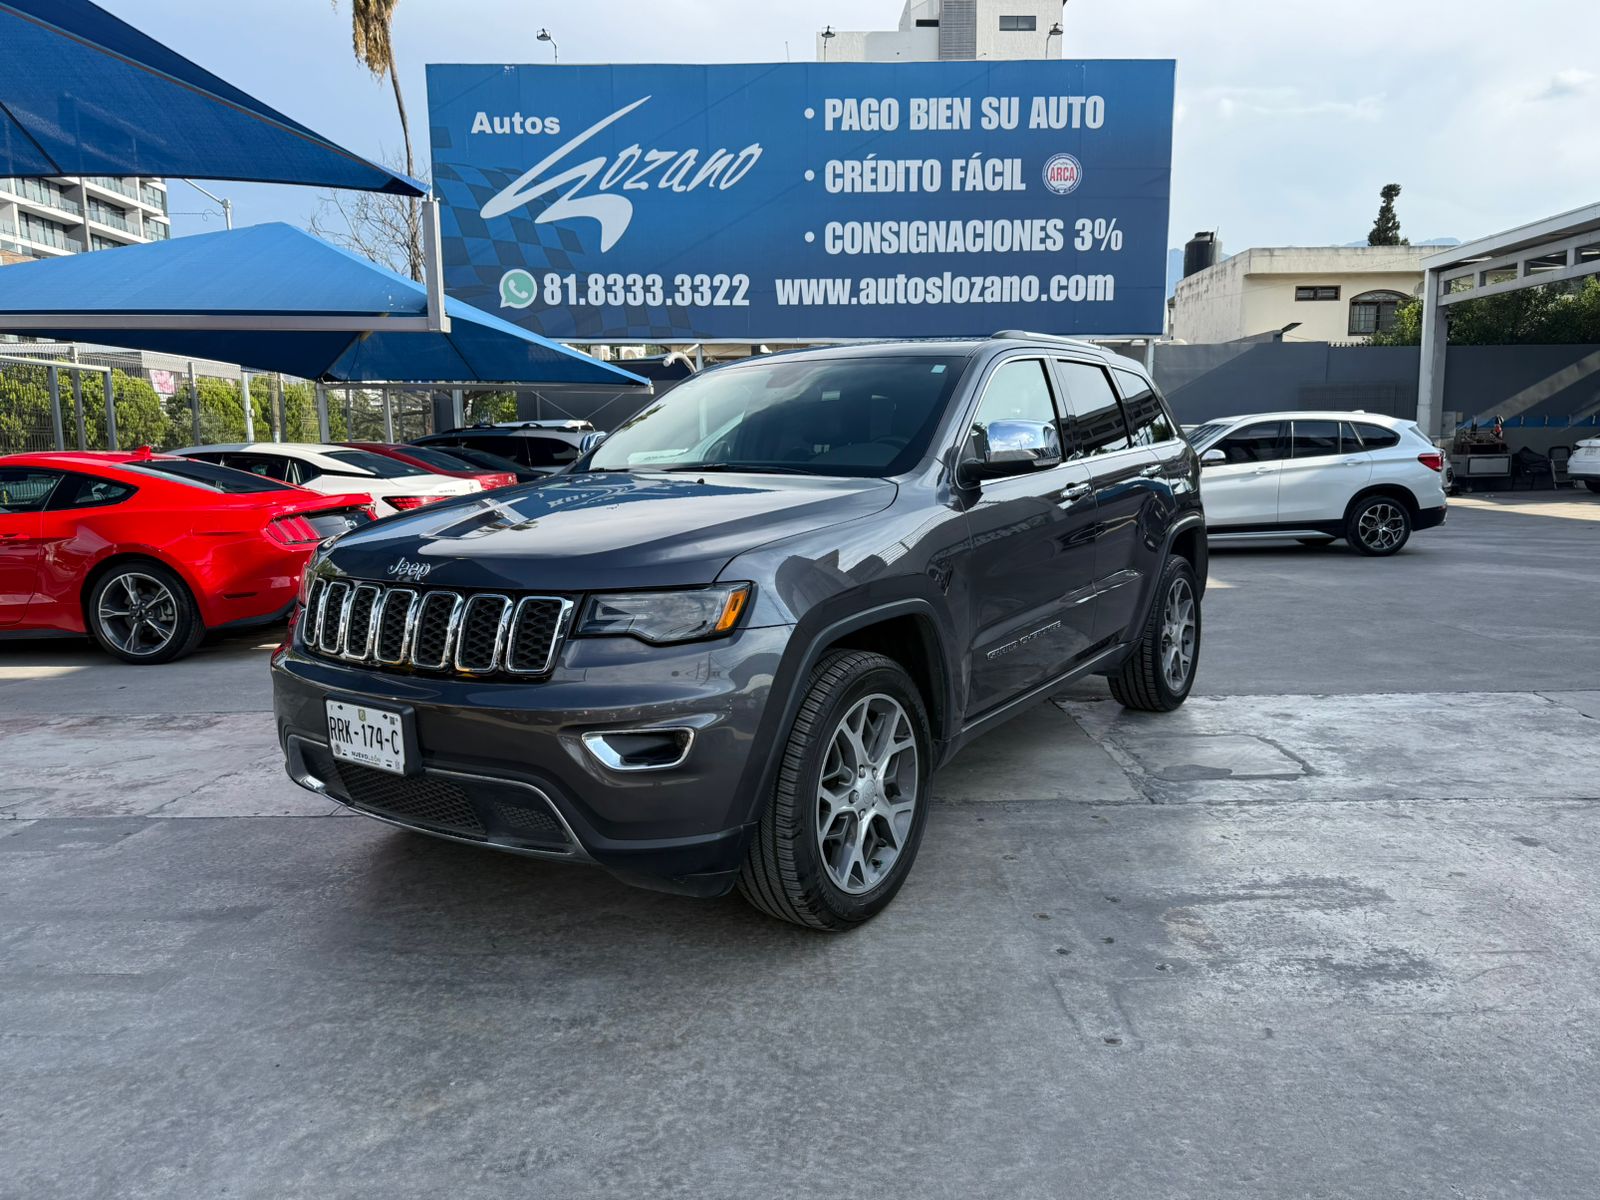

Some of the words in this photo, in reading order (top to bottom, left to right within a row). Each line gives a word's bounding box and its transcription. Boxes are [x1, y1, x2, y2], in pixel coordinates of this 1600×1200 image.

[470, 111, 561, 135] Autos
[824, 97, 899, 131] PAGO
[909, 97, 971, 130] BIEN
[980, 96, 1020, 130] SU
[1029, 95, 1105, 129] AUTO
[824, 153, 942, 193] CRÉDITO
[951, 152, 1026, 191] FÁCIL
[1050, 166, 1075, 182] ARCA
[824, 218, 1064, 254] CONSIGNACIONES
[1073, 217, 1123, 251] 3%
[543, 272, 750, 306] 81.8333.3322
[775, 271, 1115, 306] www.autoslozano.com
[388, 556, 431, 581] Jeep
[328, 715, 400, 756] RRK-174-C
